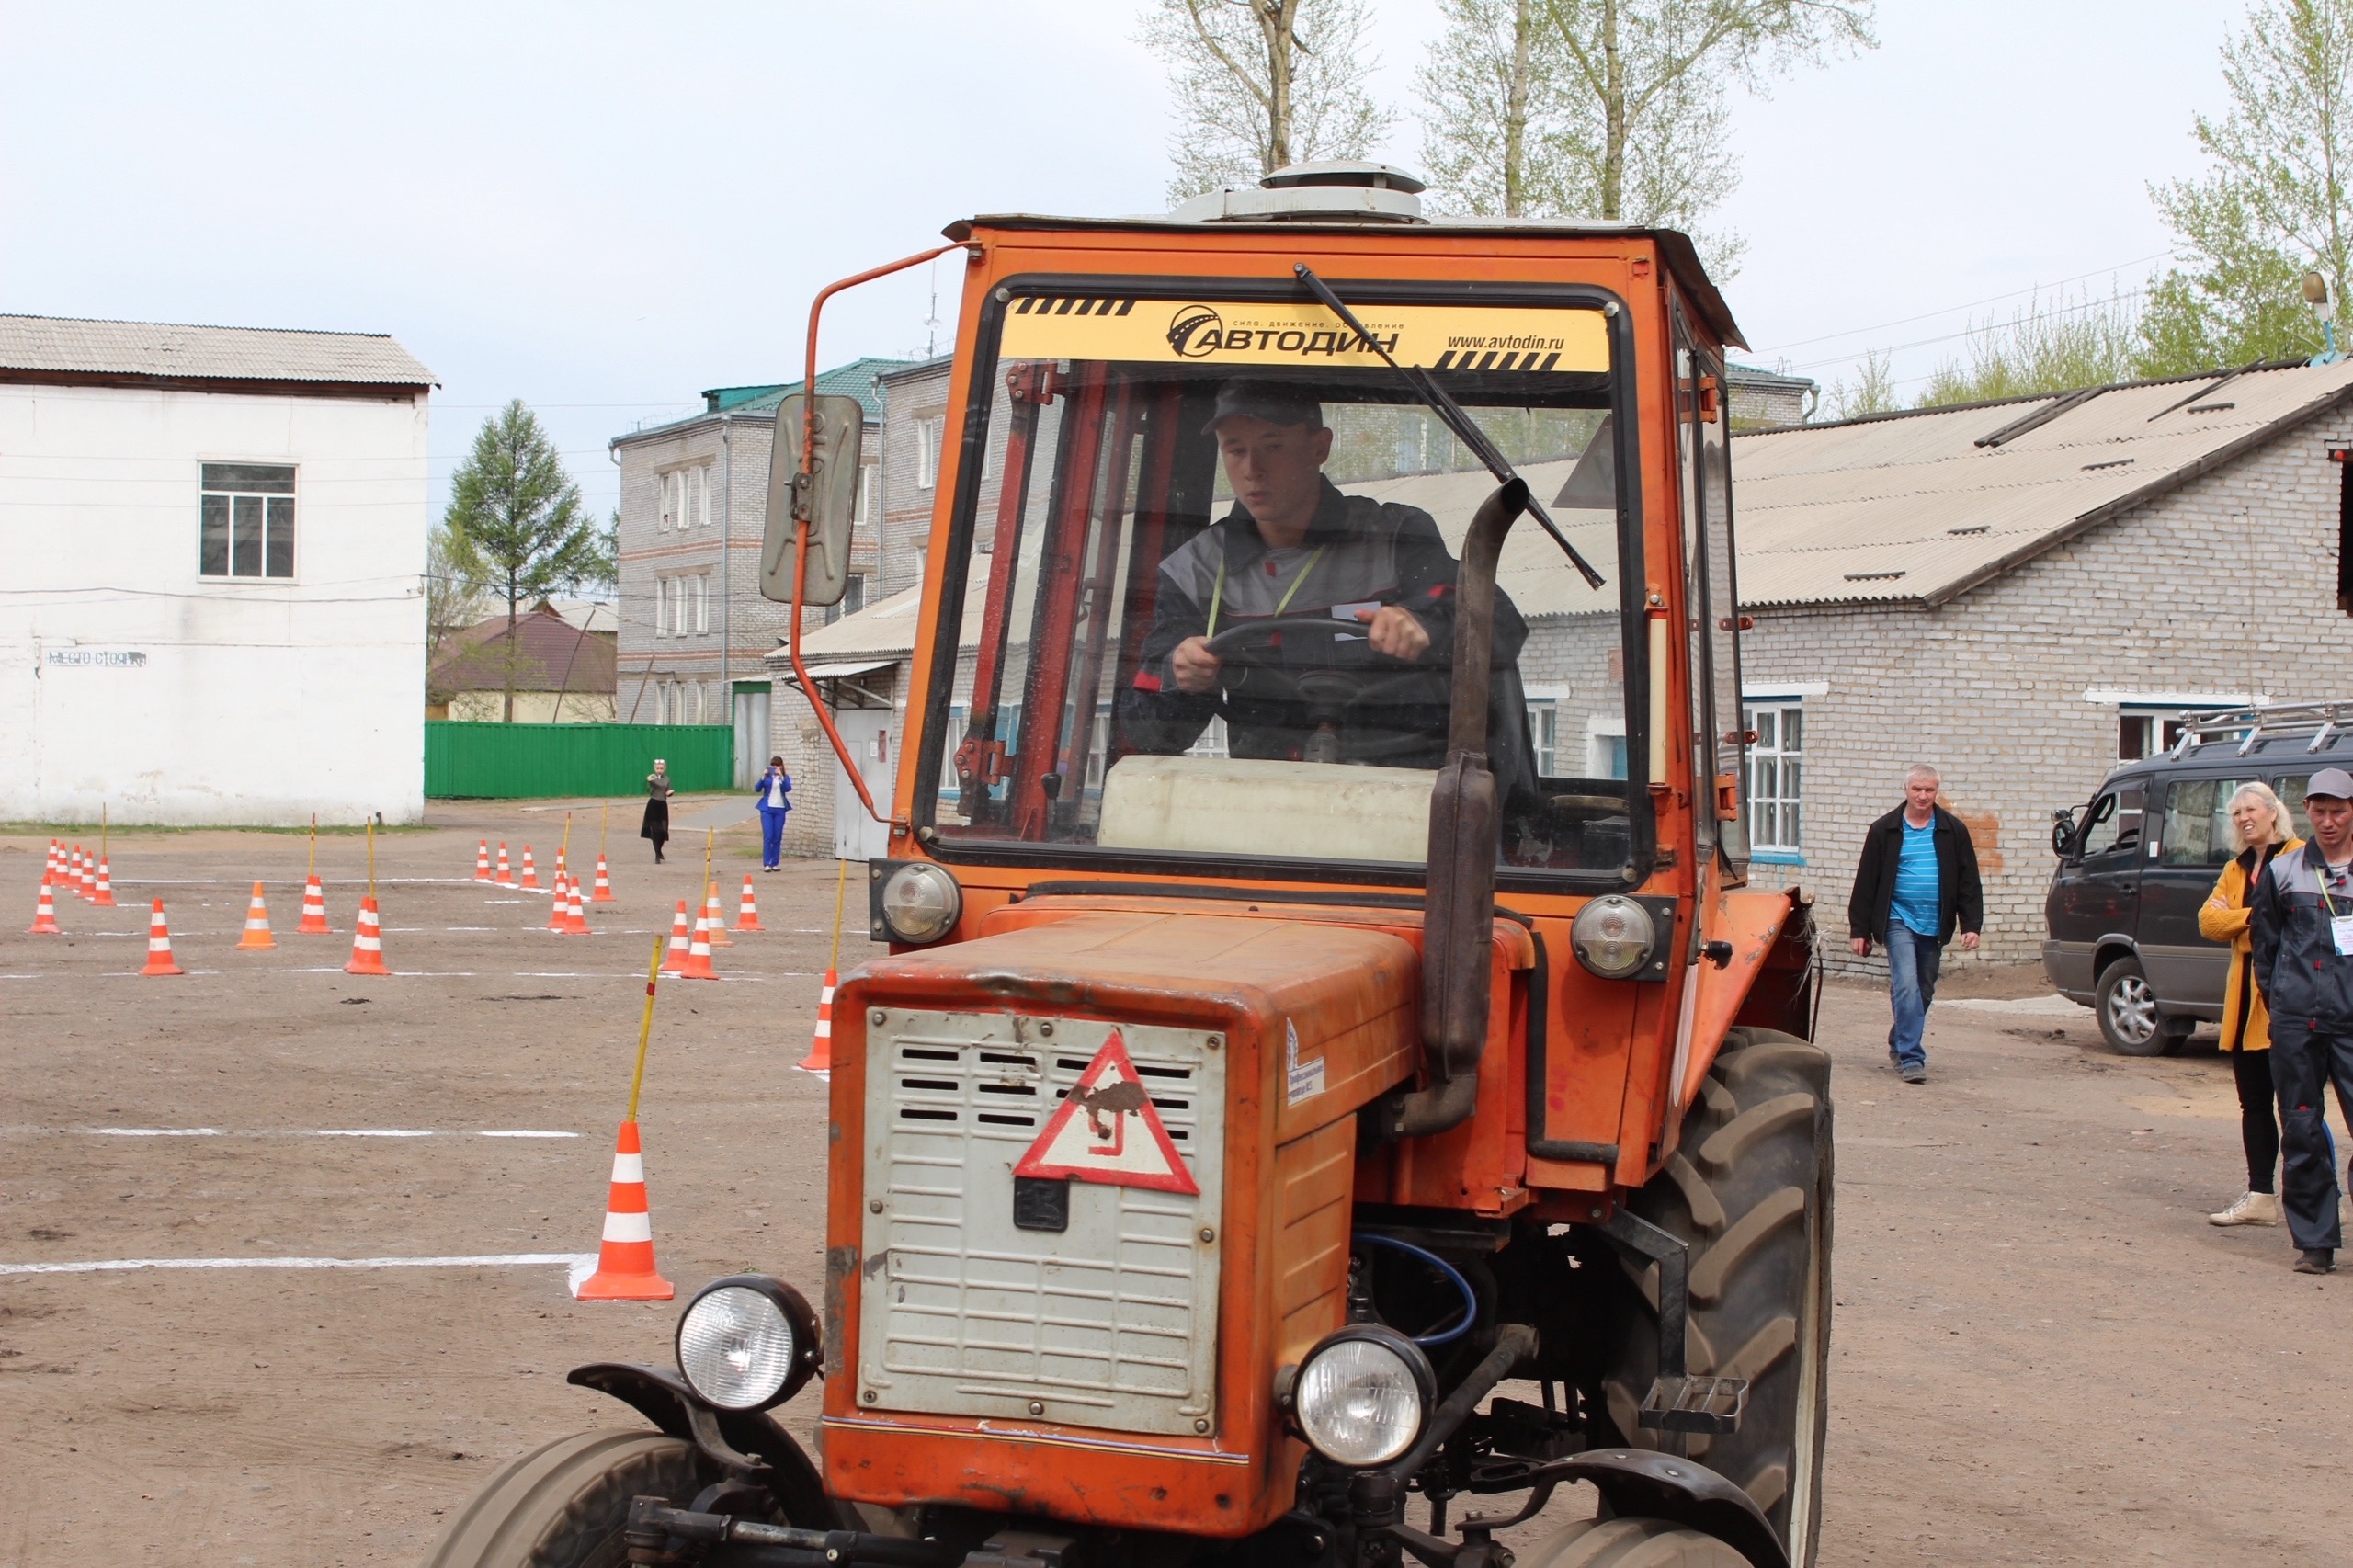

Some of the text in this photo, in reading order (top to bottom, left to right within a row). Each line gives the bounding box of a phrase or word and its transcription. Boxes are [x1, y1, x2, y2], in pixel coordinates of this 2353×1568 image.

[1335, 322, 1404, 330] обвление
[1194, 328, 1400, 357] АВТОДИН
[1448, 334, 1564, 350] www.avtodin.ru
[49, 651, 91, 664] МЕСТО
